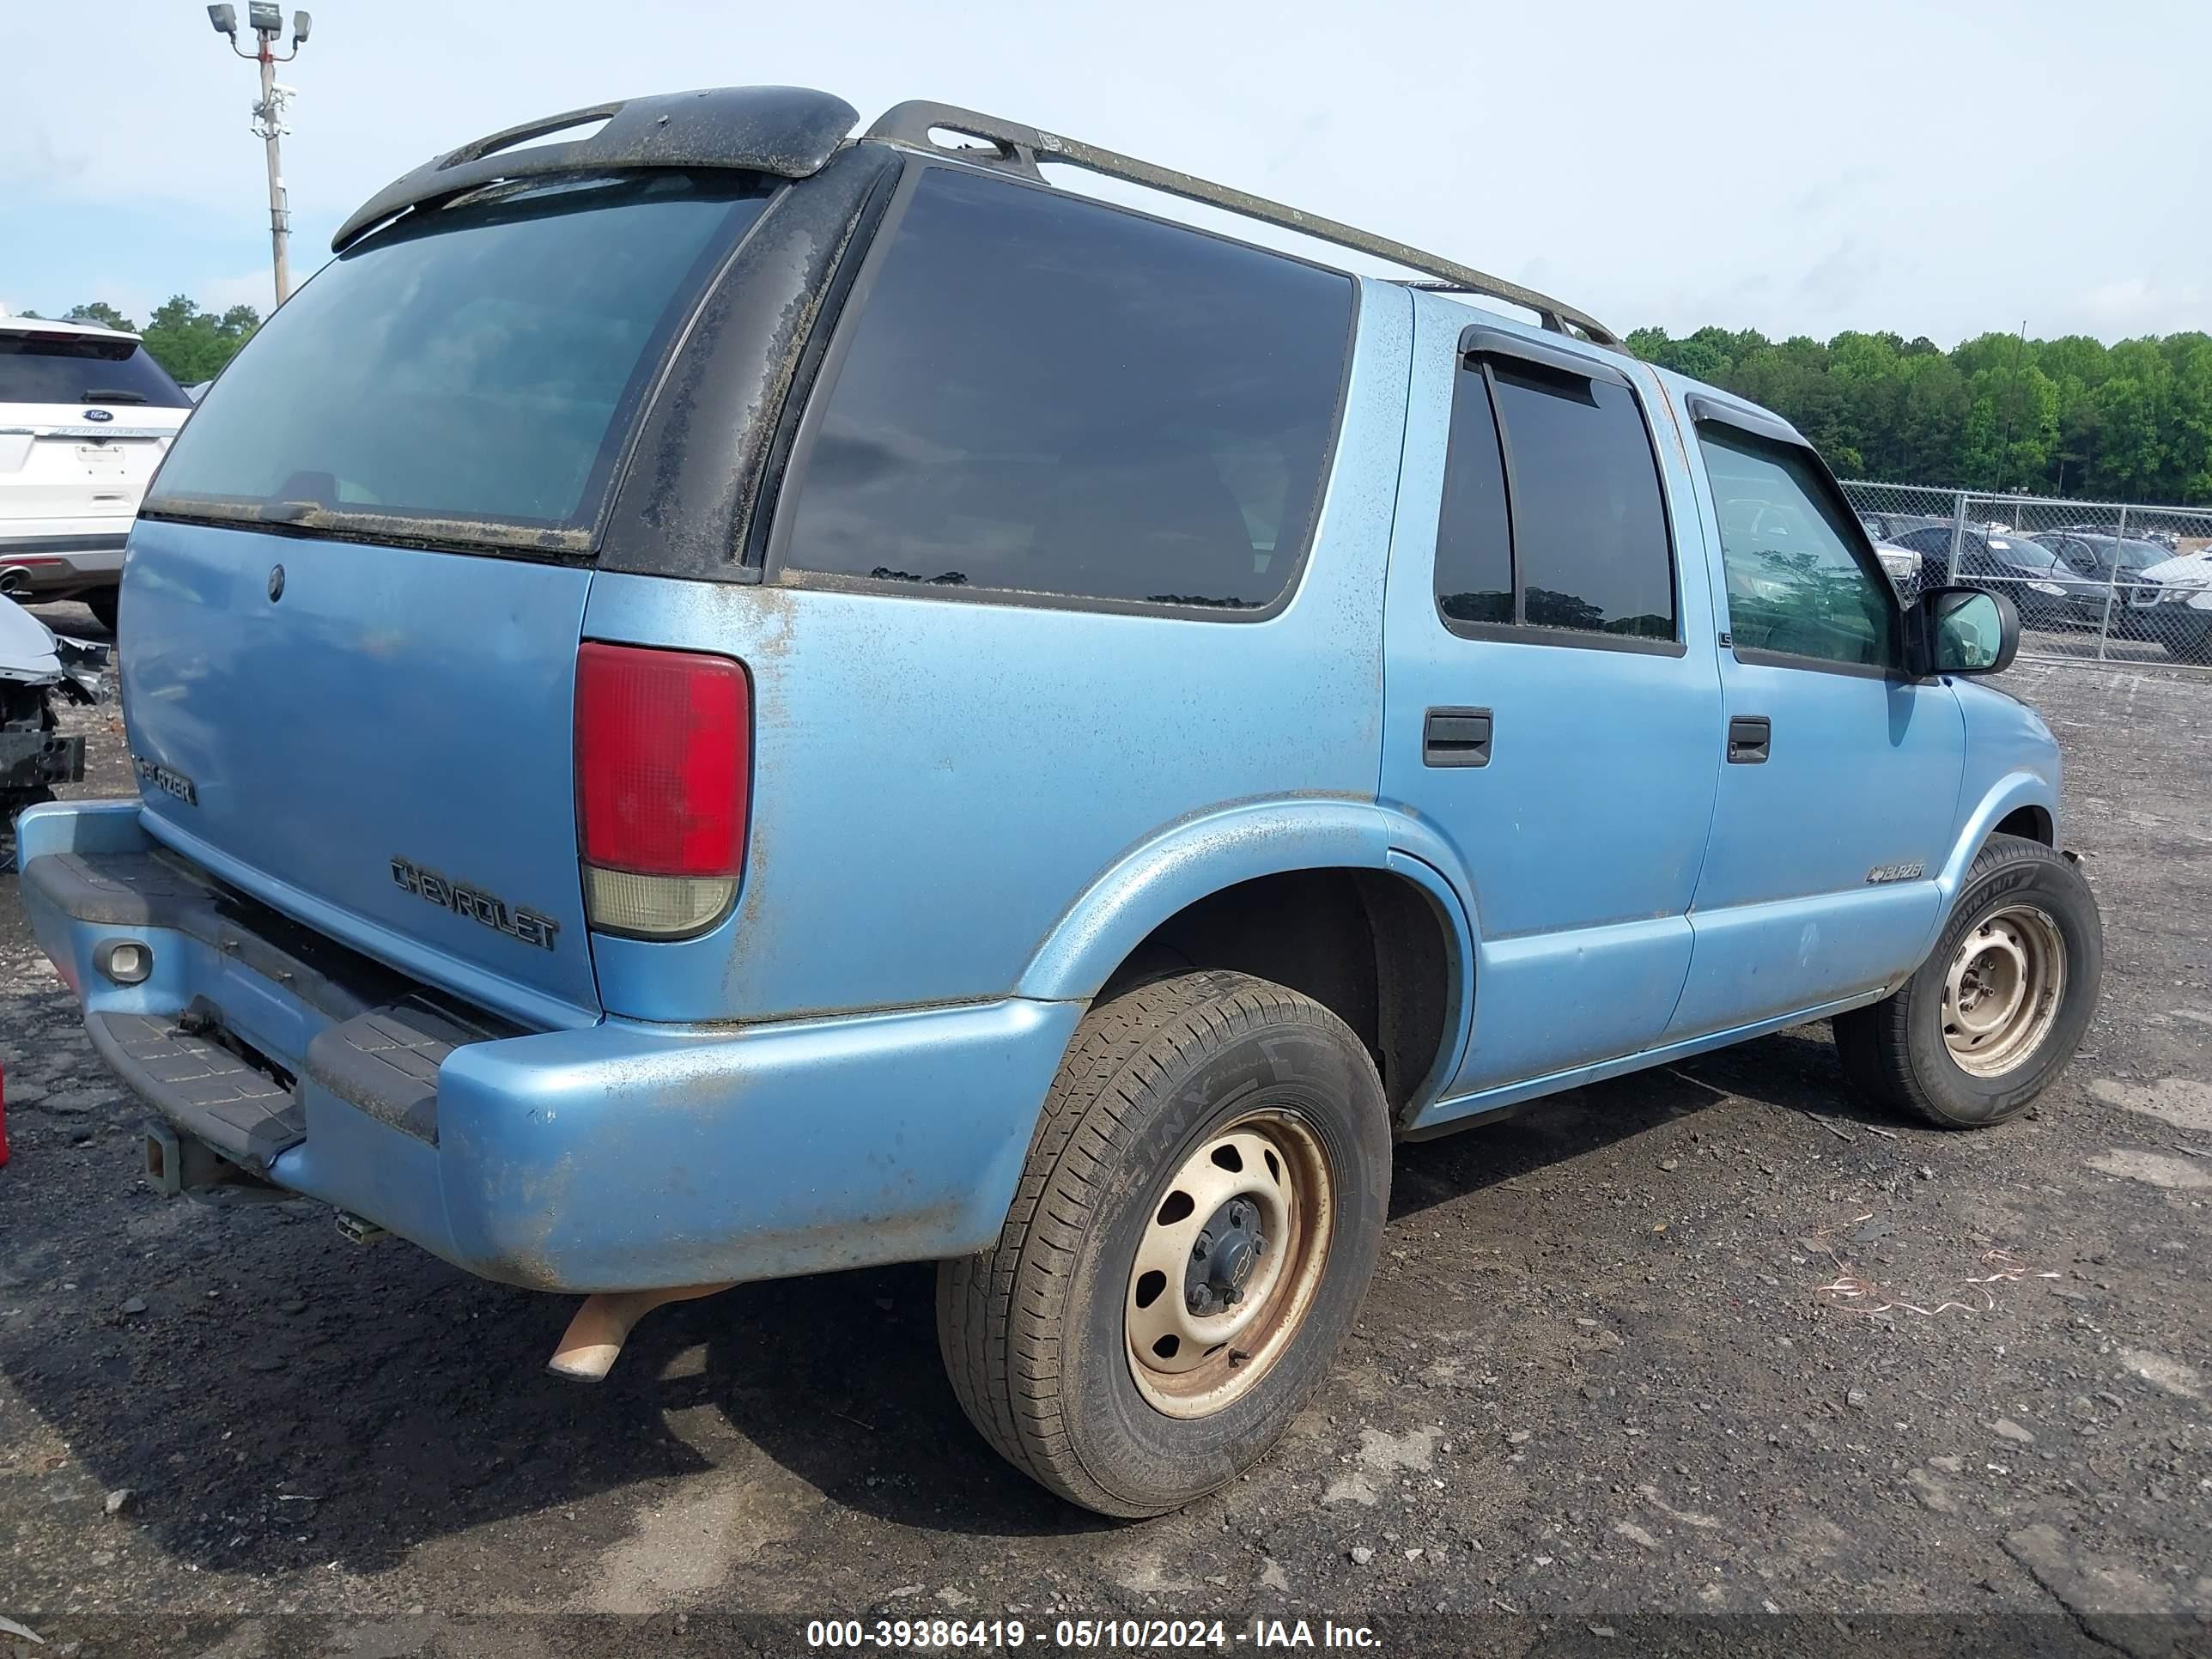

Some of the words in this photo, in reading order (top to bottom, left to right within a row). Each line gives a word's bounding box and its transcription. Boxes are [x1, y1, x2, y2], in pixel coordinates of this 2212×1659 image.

[90, 410, 108, 420] Ford
[143, 763, 192, 804] BLAZER
[390, 859, 558, 951] CHEVROLET
